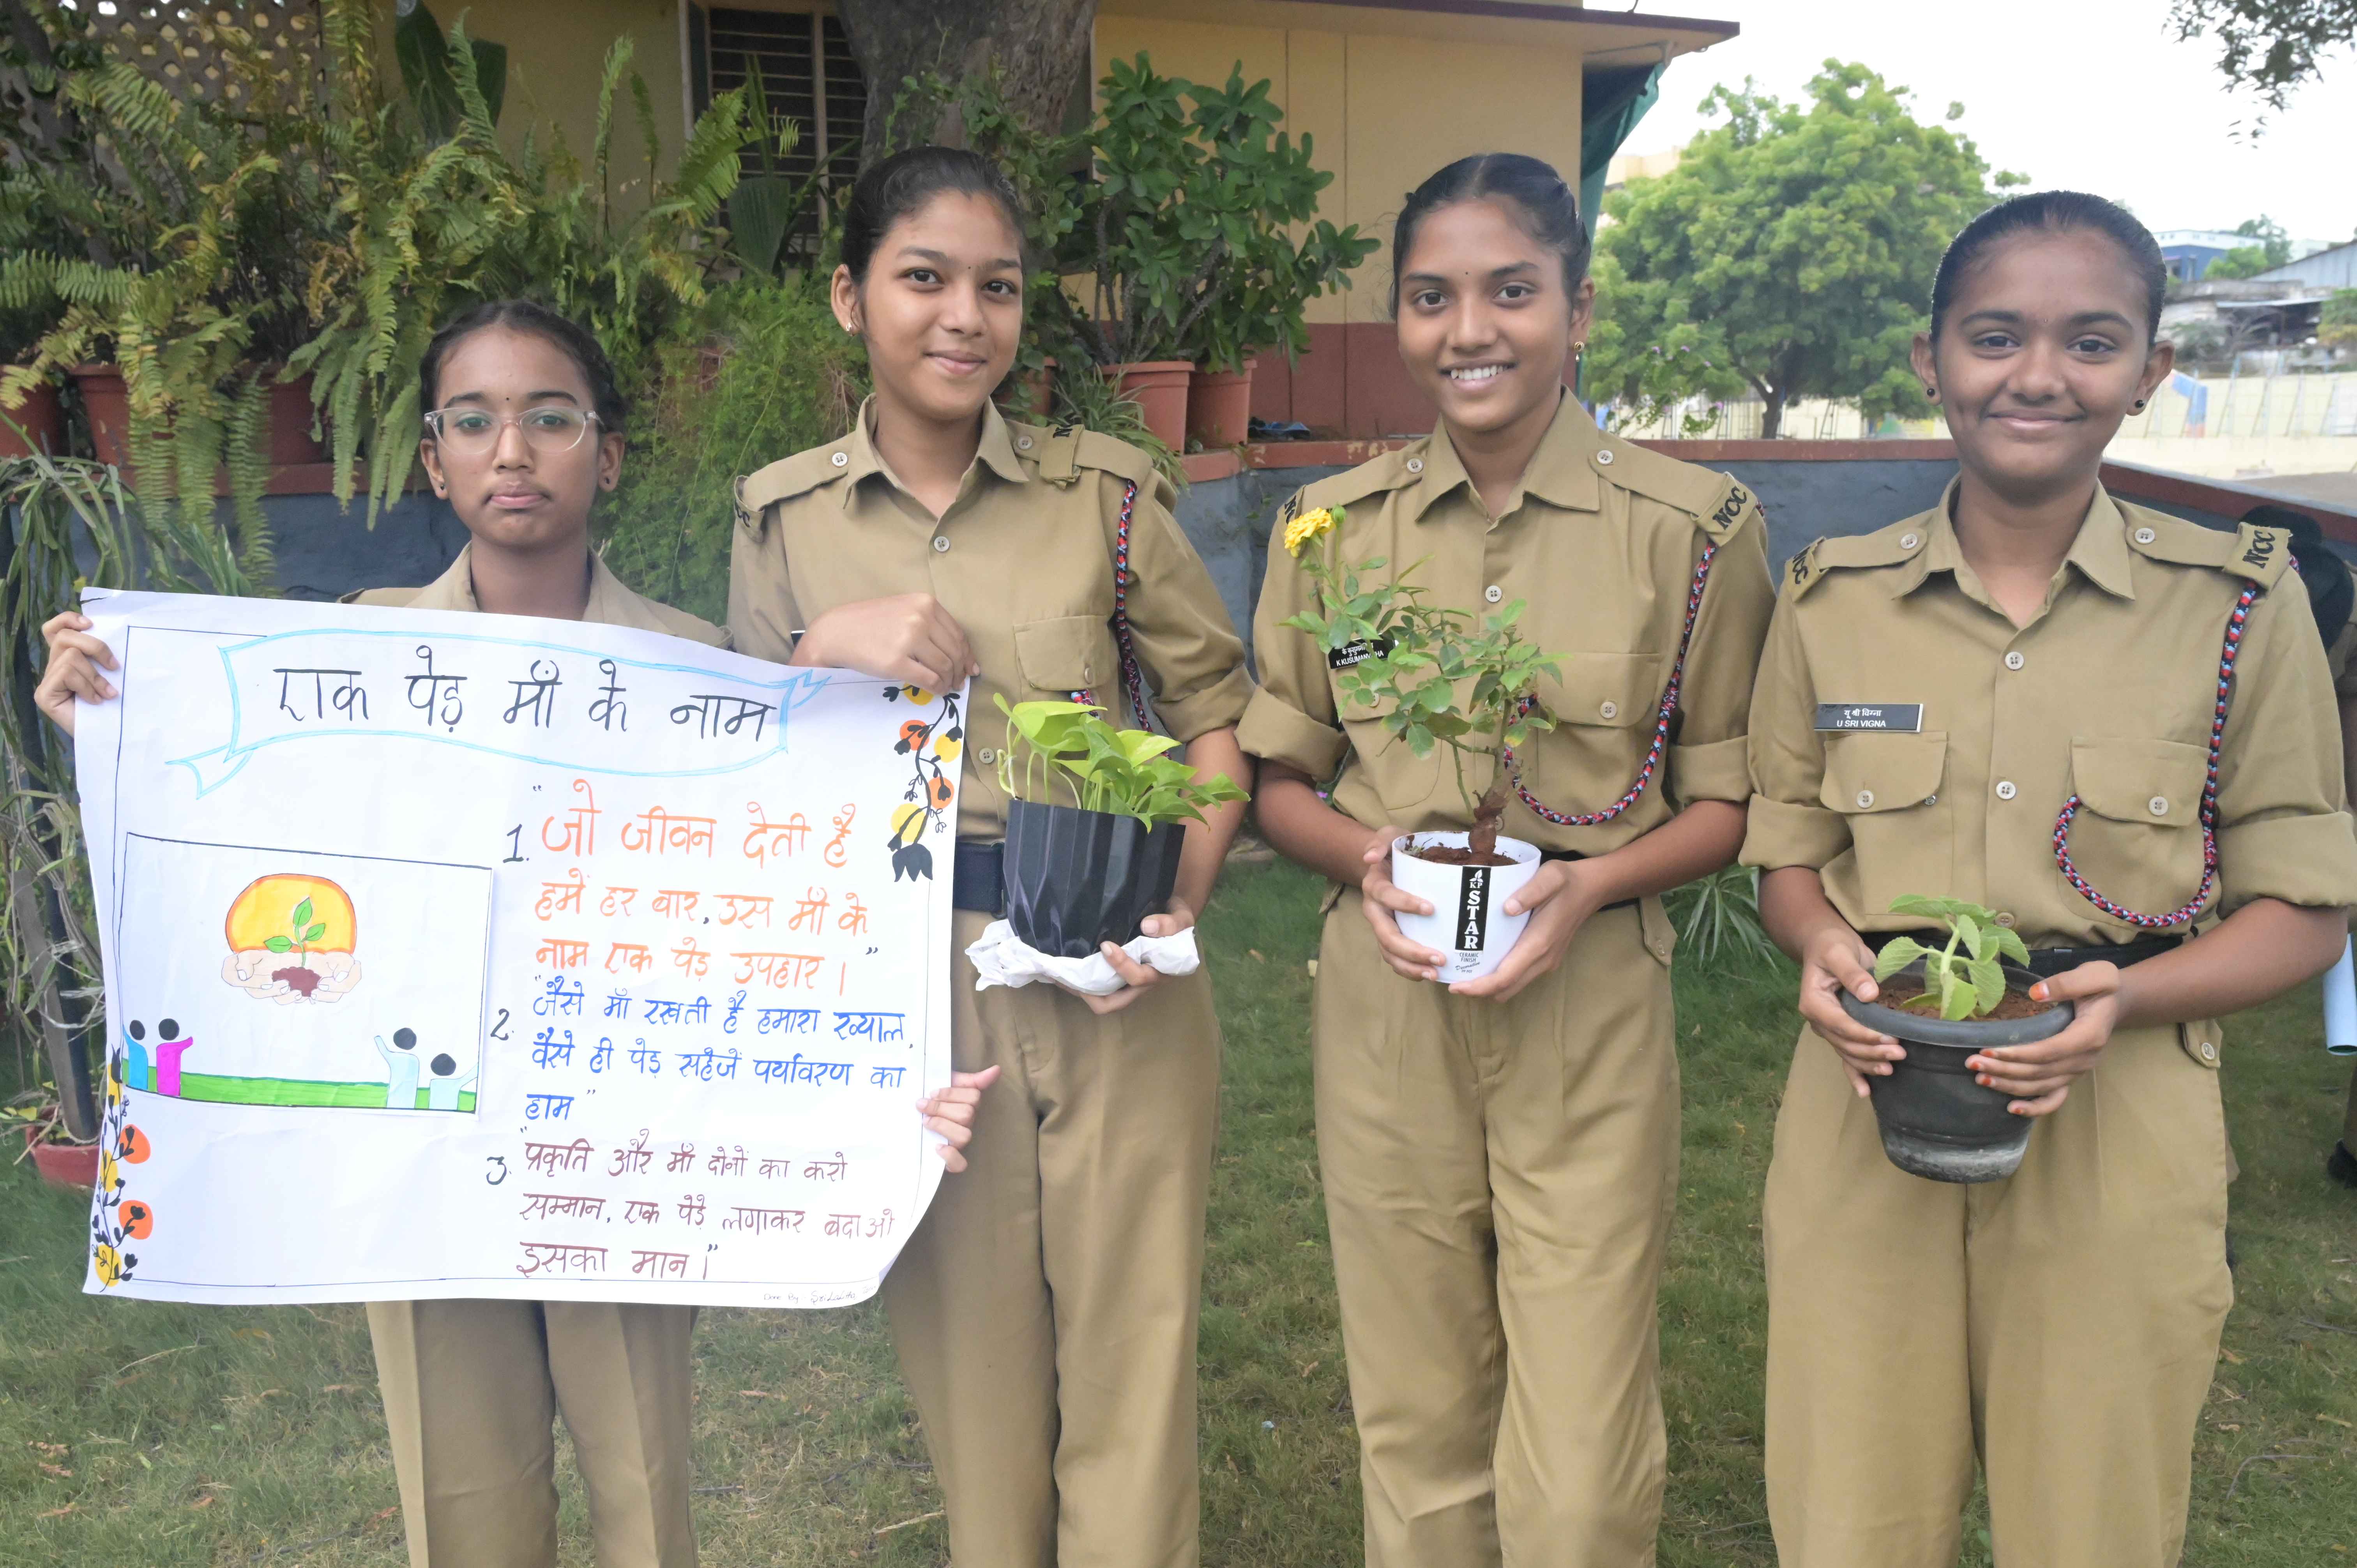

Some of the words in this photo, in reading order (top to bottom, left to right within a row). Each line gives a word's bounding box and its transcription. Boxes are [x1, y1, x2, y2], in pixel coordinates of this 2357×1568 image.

[1712, 486, 1747, 530] NCC
[1793, 546, 1810, 584] NCC
[2242, 530, 2275, 569] NCC
[1341, 650, 1384, 665] KUSUMANVHA
[1844, 710, 1851, 719] यू
[1852, 708, 1861, 717] श्री
[1464, 890, 1481, 949] STAR
